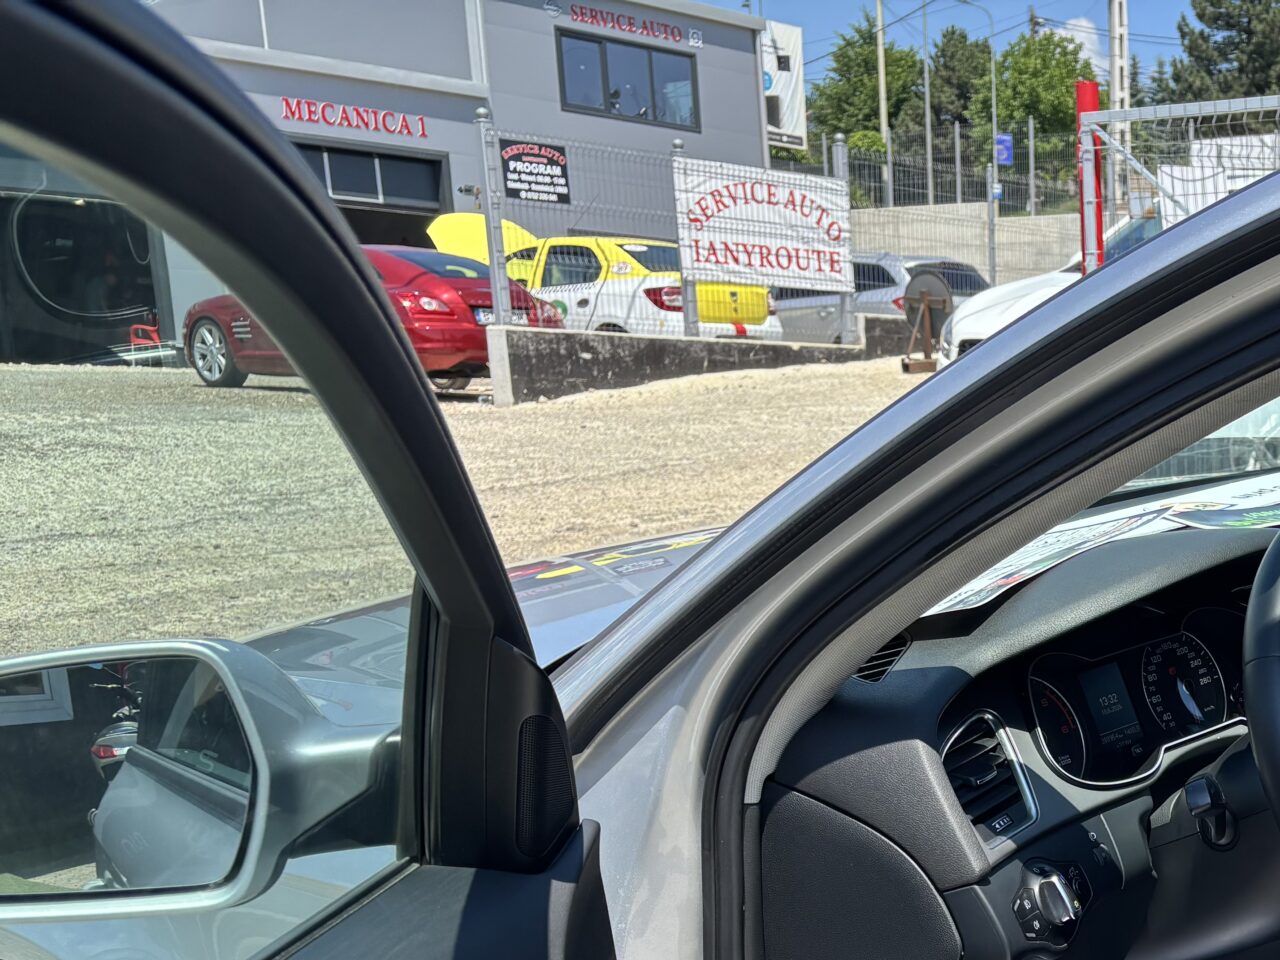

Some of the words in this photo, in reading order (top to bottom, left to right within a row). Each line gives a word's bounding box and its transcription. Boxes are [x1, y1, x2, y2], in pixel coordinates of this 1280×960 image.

[570, 3, 637, 34] SERVICE
[638, 19, 683, 43] AUTO
[280, 96, 413, 137] MECANICA
[416, 115, 429, 138] 1
[508, 160, 563, 177] PROGRAM
[686, 181, 779, 232] SERVICE
[783, 189, 843, 242] AUTO
[692, 238, 843, 274] IANYROUTE
